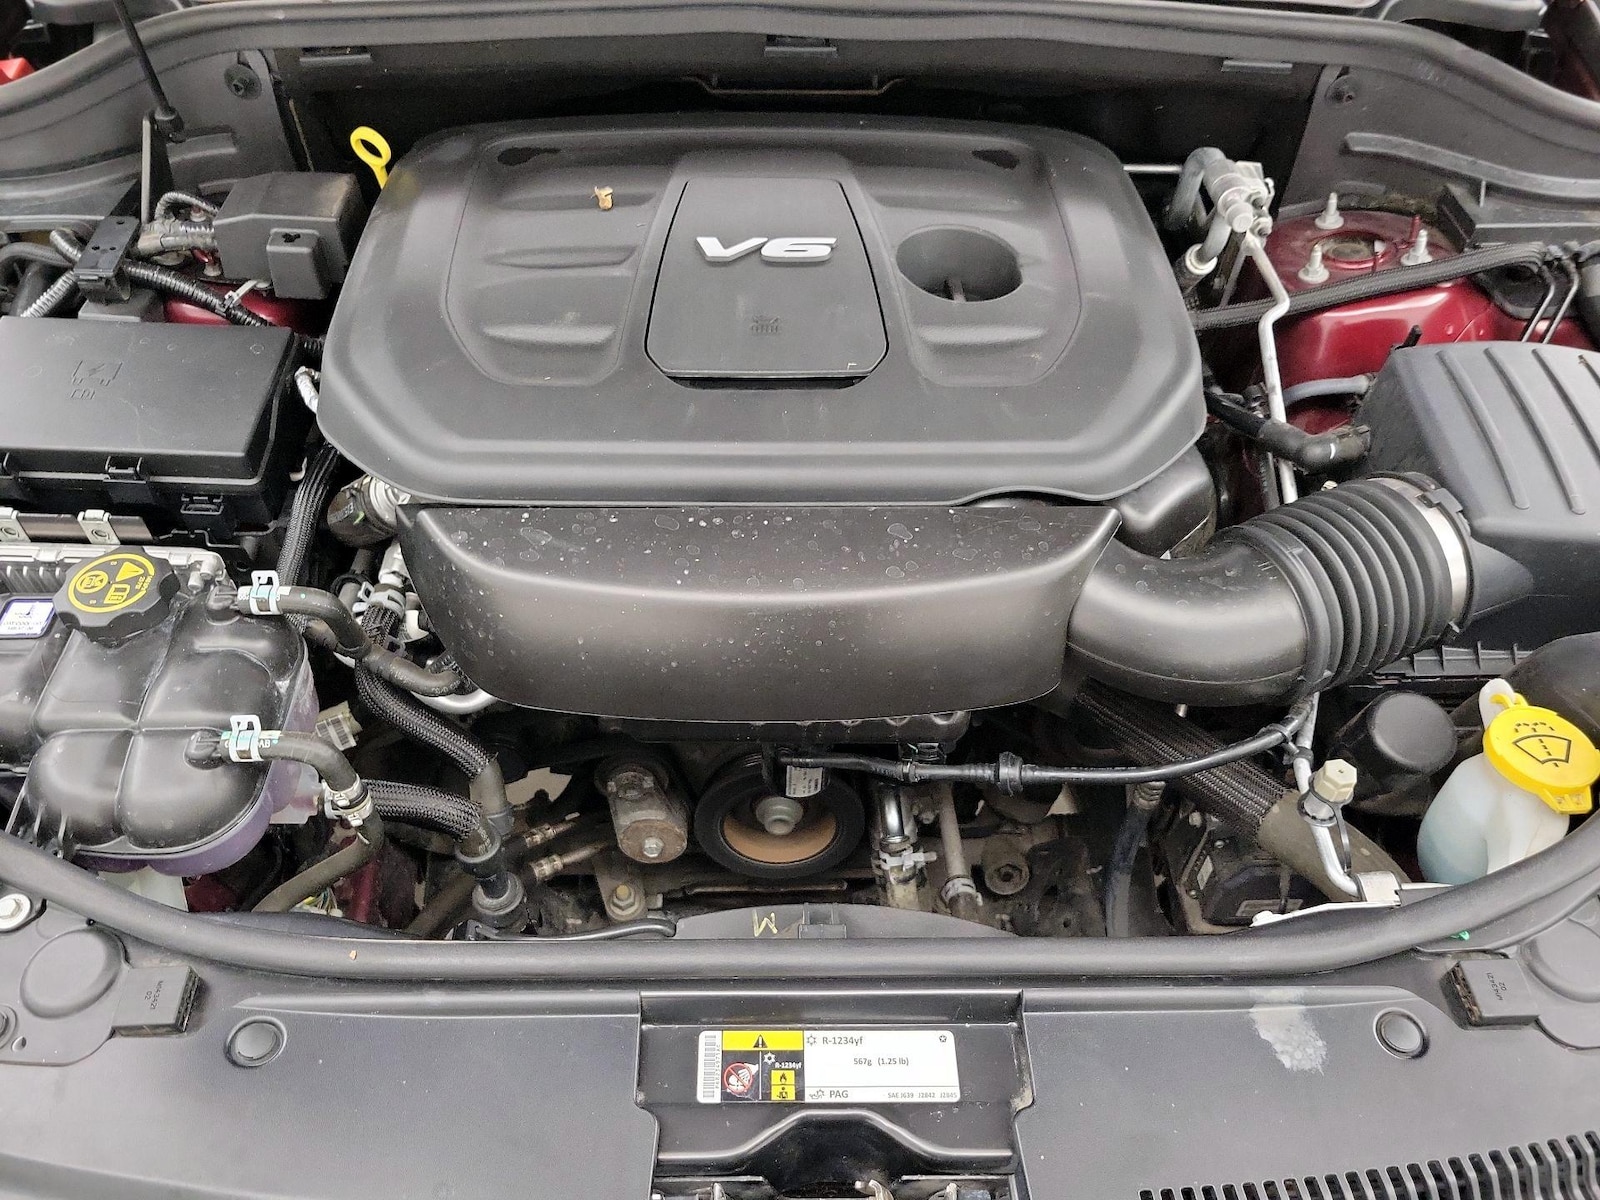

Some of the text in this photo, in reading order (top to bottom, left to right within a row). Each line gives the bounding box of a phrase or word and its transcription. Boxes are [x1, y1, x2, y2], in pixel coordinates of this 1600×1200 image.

[695, 236, 838, 263] V6
[822, 1035, 863, 1046] R-1234yf
[853, 1057, 909, 1067] 567g (1.25 lb)
[829, 1089, 849, 1099] PAG
